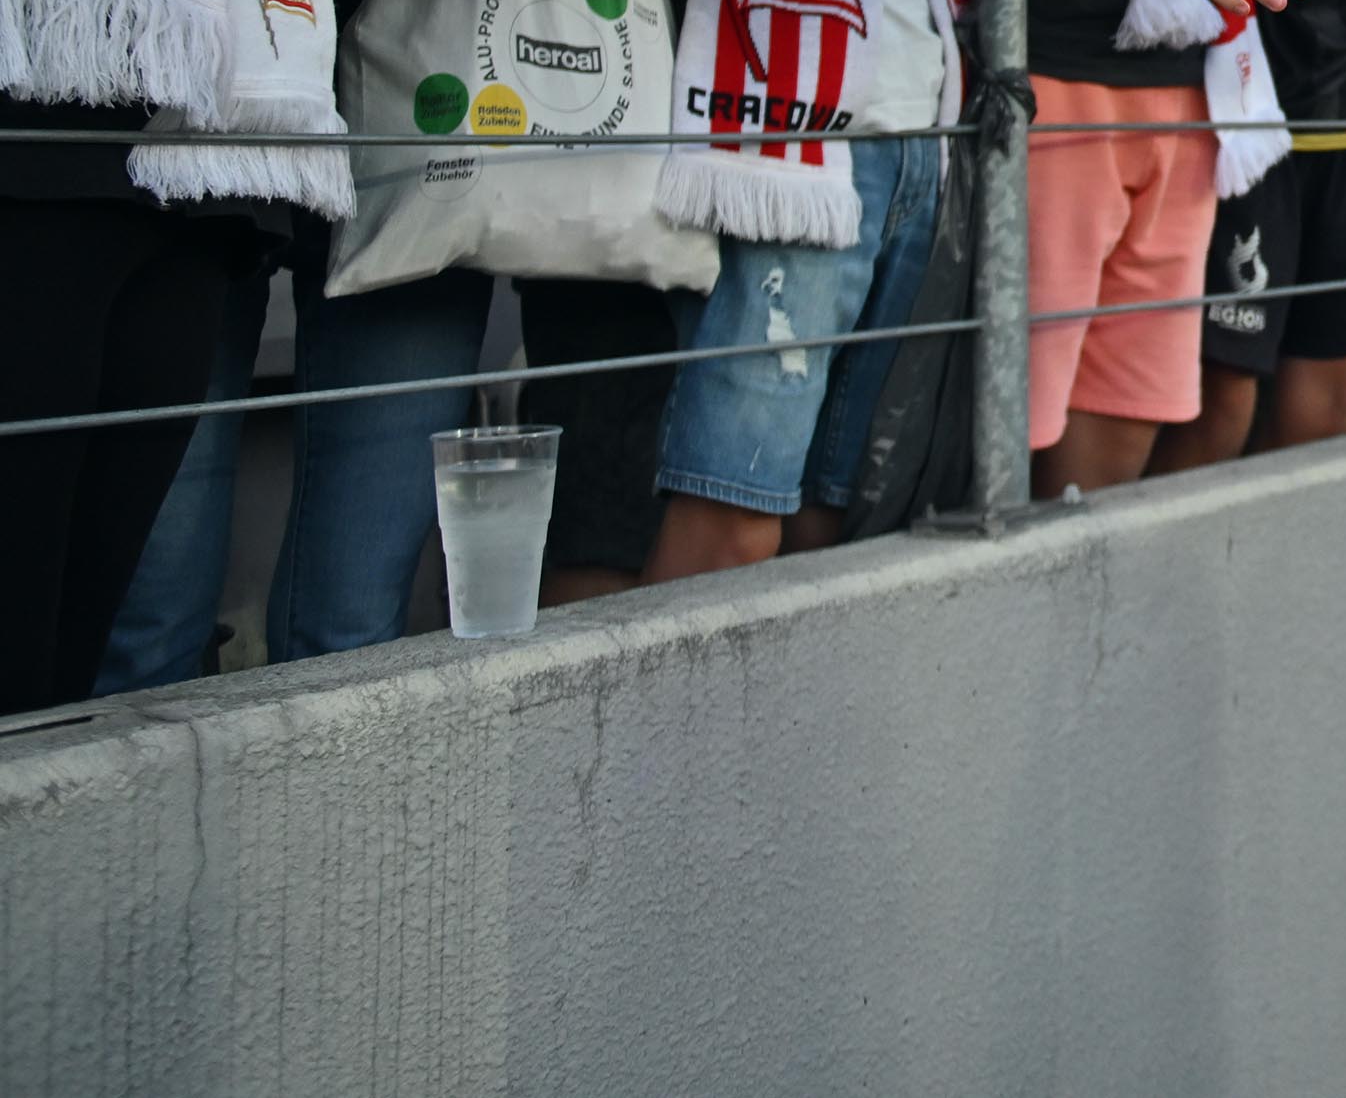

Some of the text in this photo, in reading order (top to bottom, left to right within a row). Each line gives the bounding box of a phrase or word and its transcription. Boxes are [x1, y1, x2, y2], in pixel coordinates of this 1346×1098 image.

[518, 38, 600, 71] heroal
[614, 19, 633, 89] SACHE
[687, 86, 853, 133] CRACOVIA
[425, 169, 473, 183] Zubehör
[426, 157, 475, 172] Fenster
